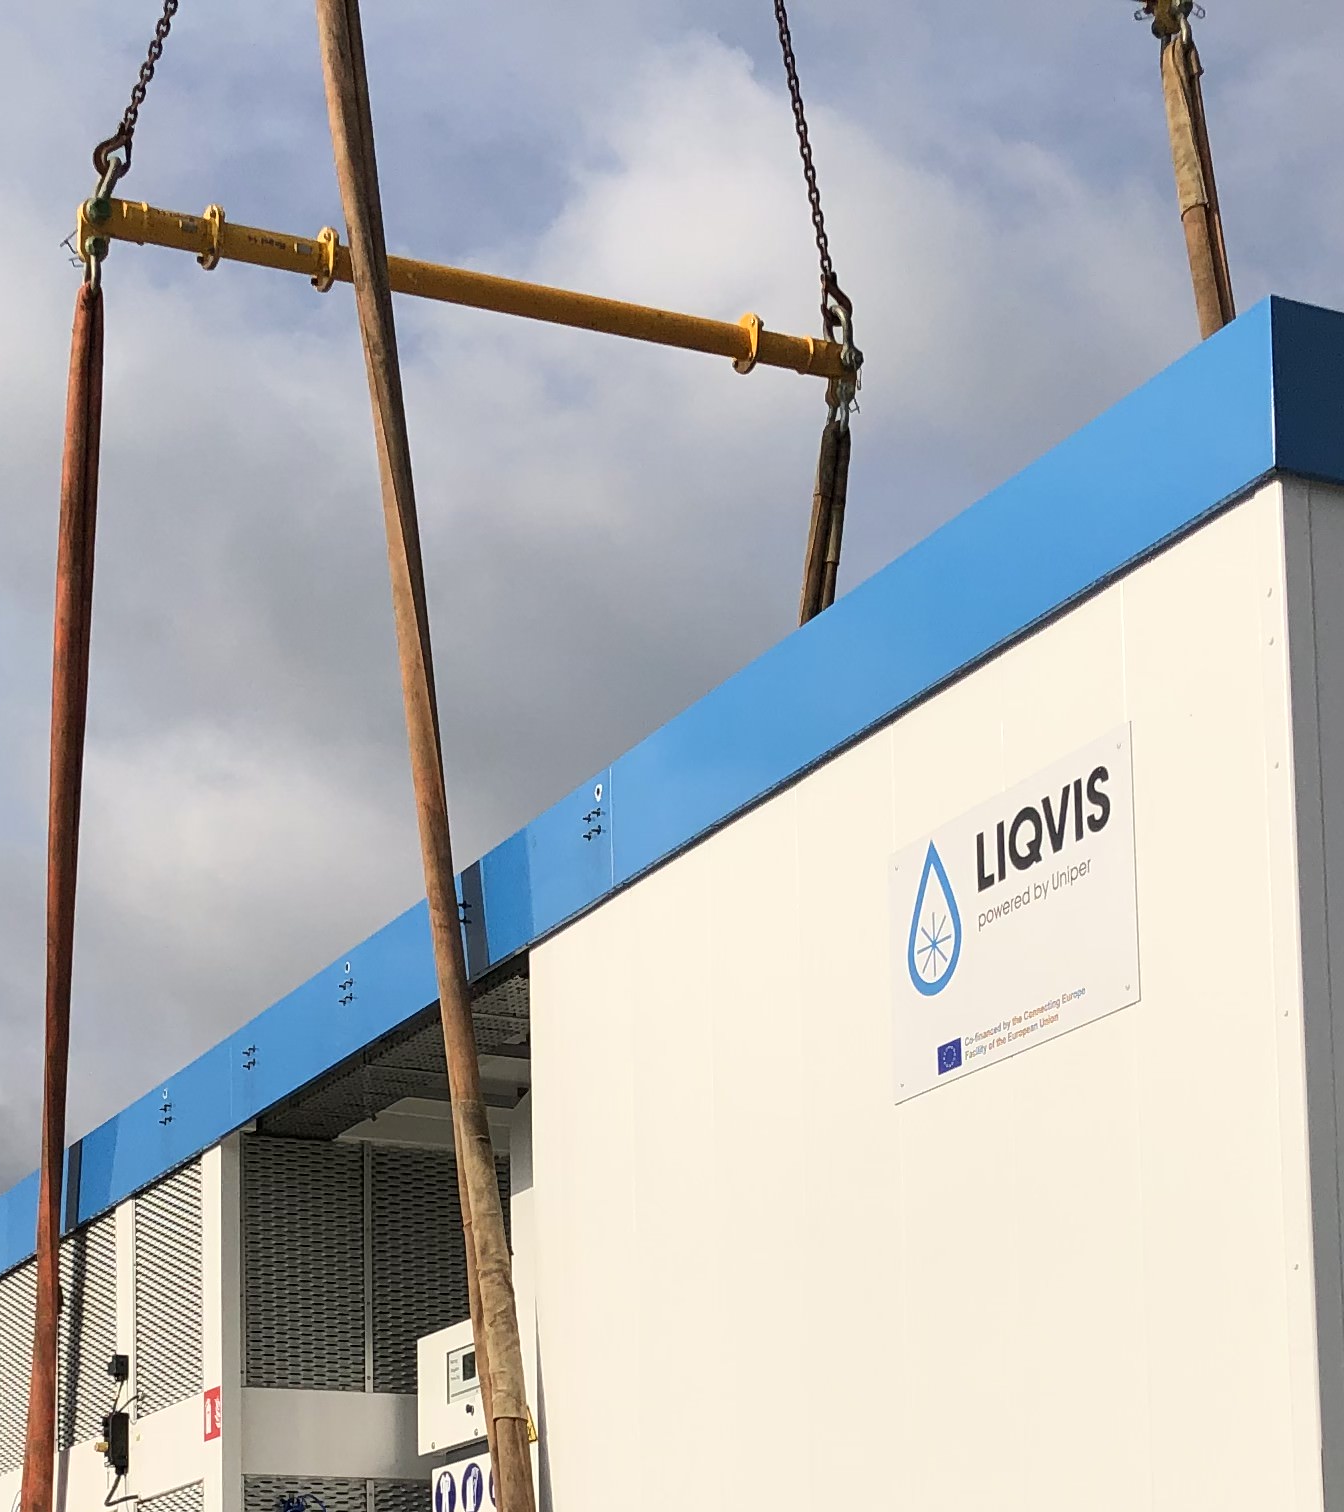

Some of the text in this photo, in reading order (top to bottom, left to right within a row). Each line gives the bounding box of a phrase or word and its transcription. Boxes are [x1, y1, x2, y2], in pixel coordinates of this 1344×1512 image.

[976, 765, 1111, 893] LIQVIS
[978, 859, 1091, 932] powered by Uniper
[1003, 1020, 1011, 1031] by
[1061, 987, 1086, 1004] Europe
